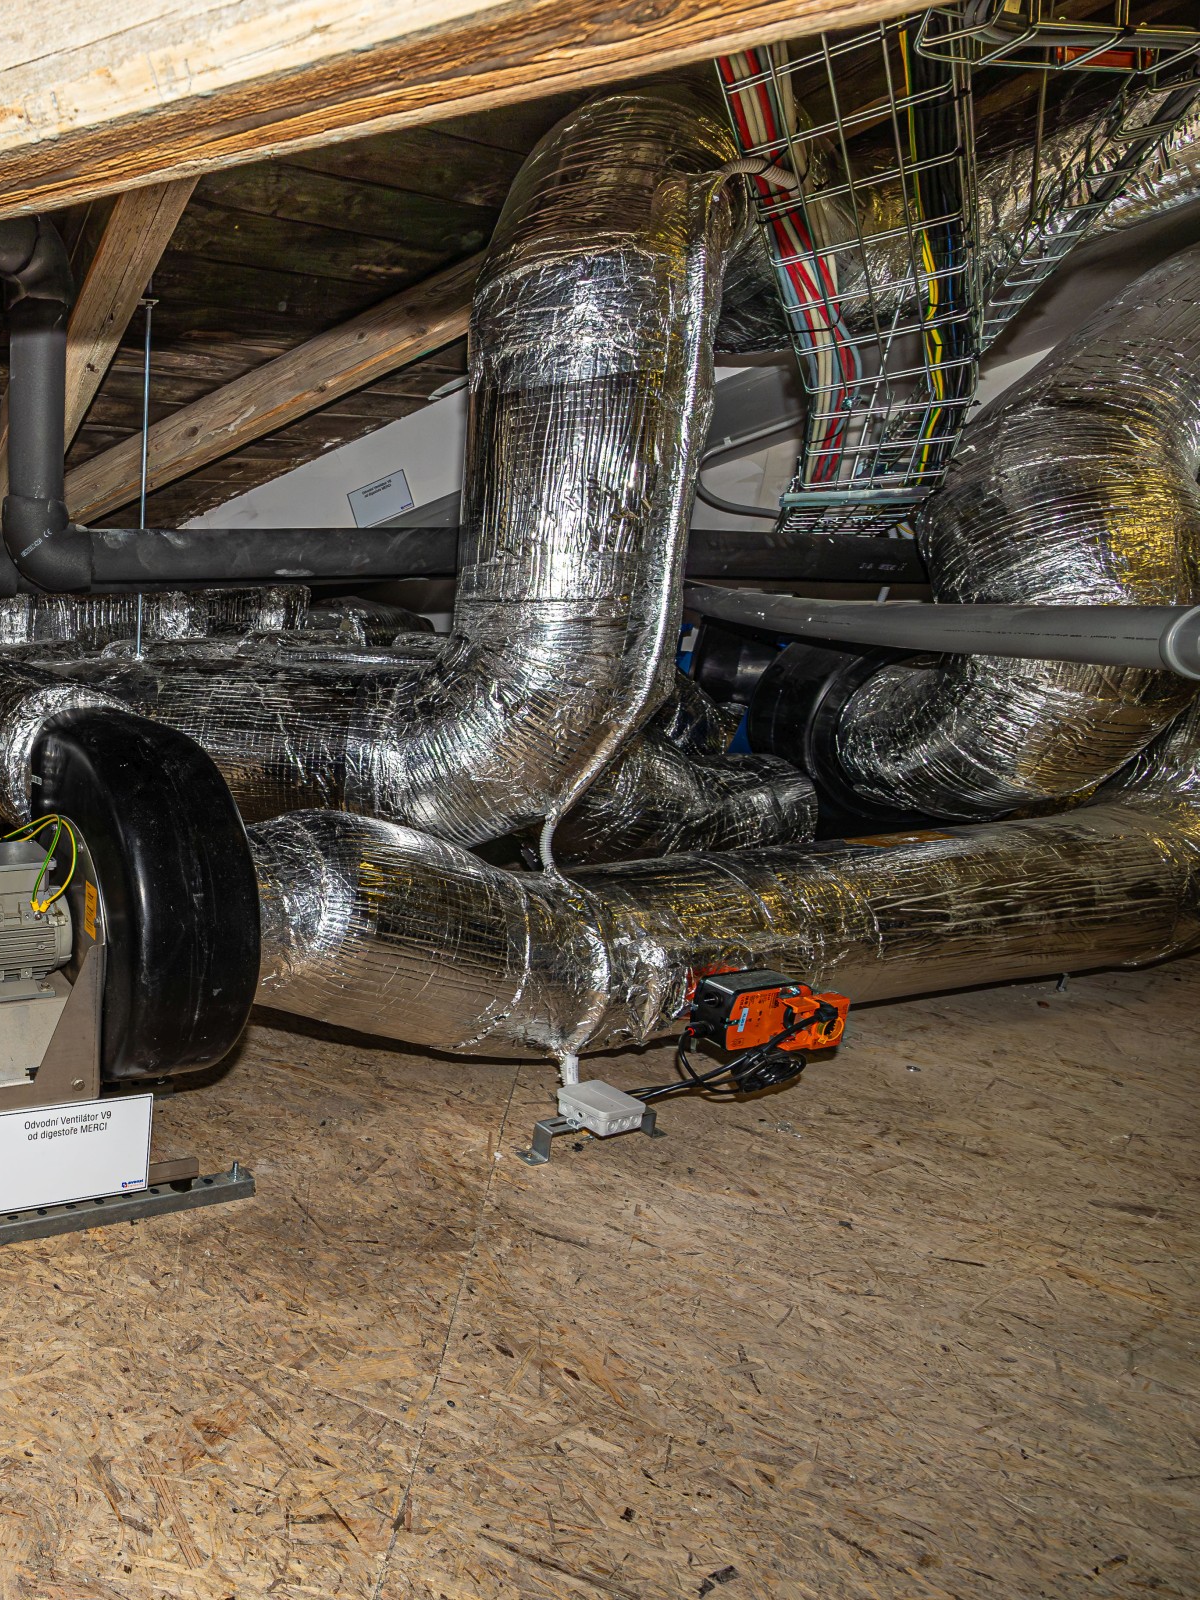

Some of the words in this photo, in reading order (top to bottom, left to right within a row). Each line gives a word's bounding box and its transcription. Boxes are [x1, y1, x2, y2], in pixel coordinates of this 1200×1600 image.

[24, 1116, 59, 1131] Odvodní
[60, 1113, 99, 1126] Ventilátor
[100, 1110, 113, 1120] V9
[27, 1131, 39, 1141] od
[40, 1126, 78, 1140] digestoře
[80, 1122, 108, 1134] MERCI
